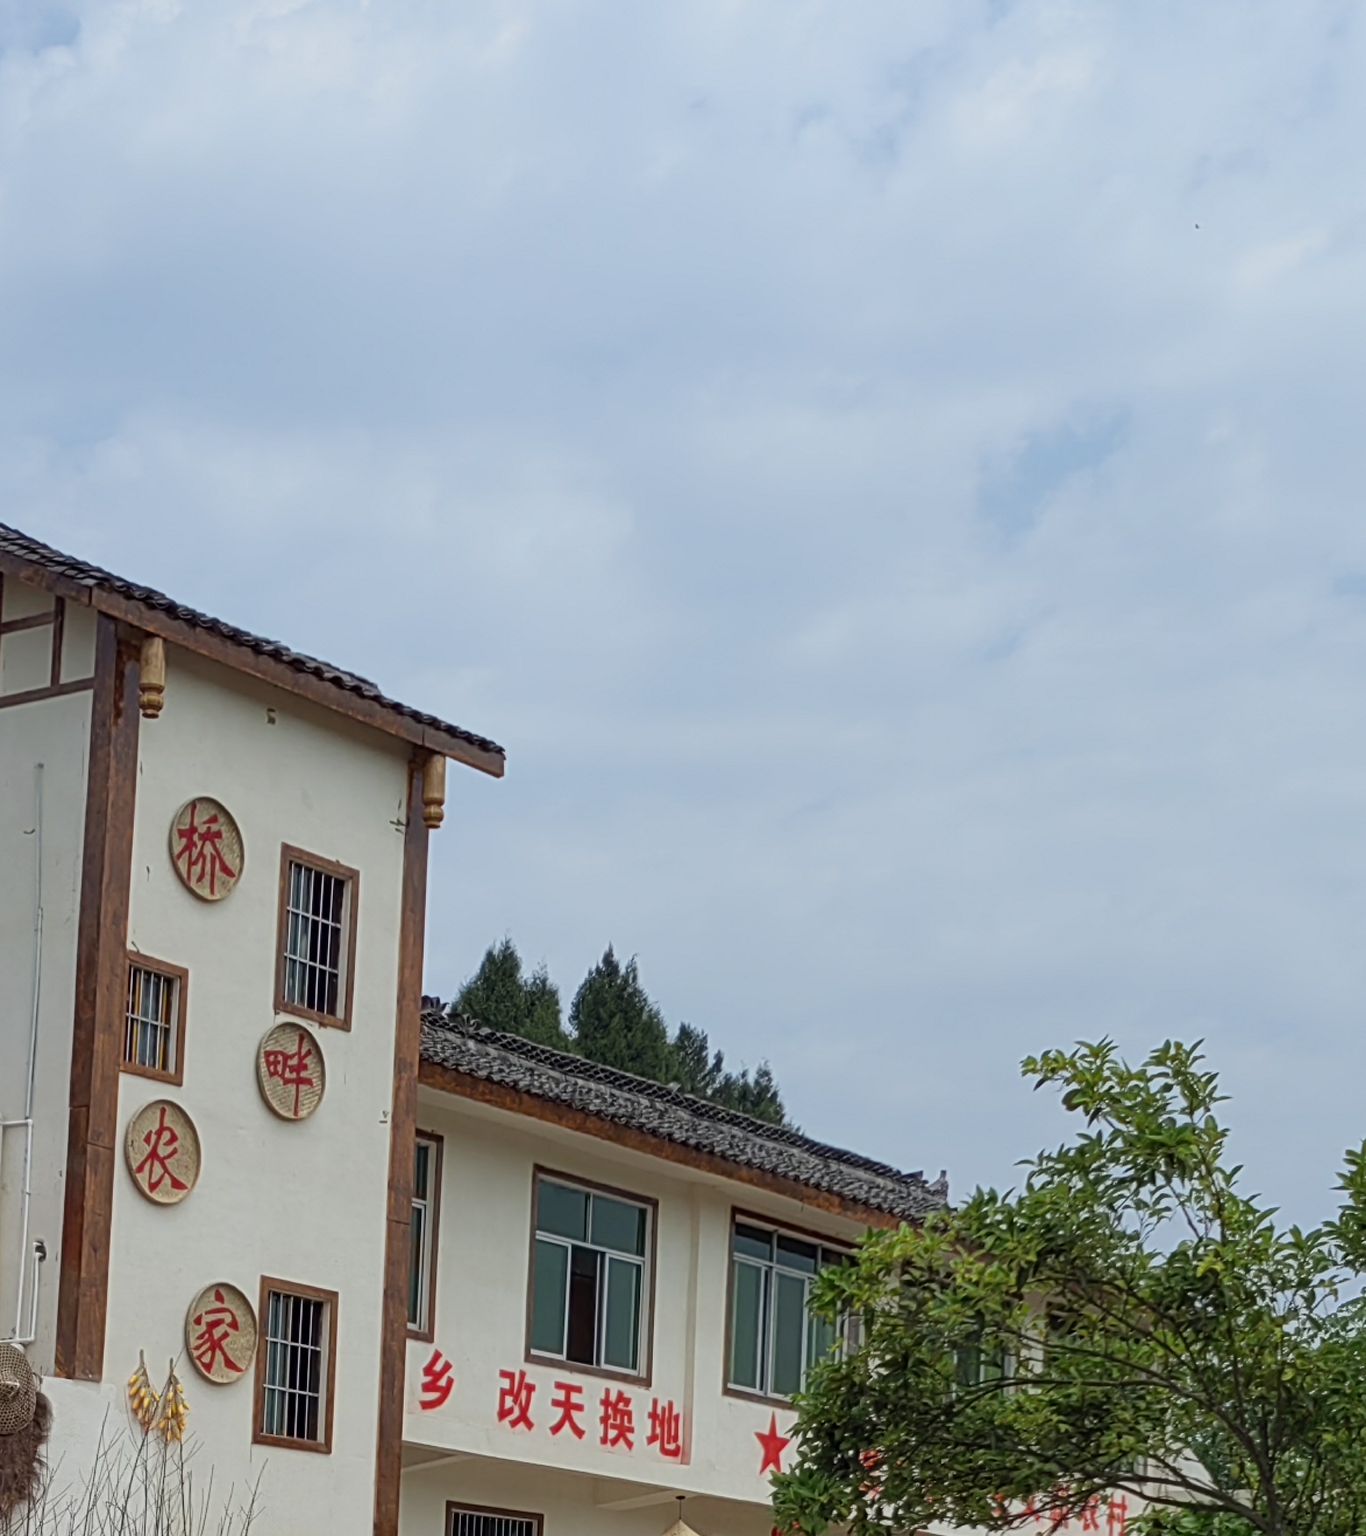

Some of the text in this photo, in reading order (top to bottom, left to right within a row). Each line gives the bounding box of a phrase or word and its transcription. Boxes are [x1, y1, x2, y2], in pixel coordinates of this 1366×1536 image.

[135, 801, 314, 1374] 桥 畔 农 家
[419, 1349, 455, 1411] 乡
[496, 1368, 681, 1457] 改天换地
